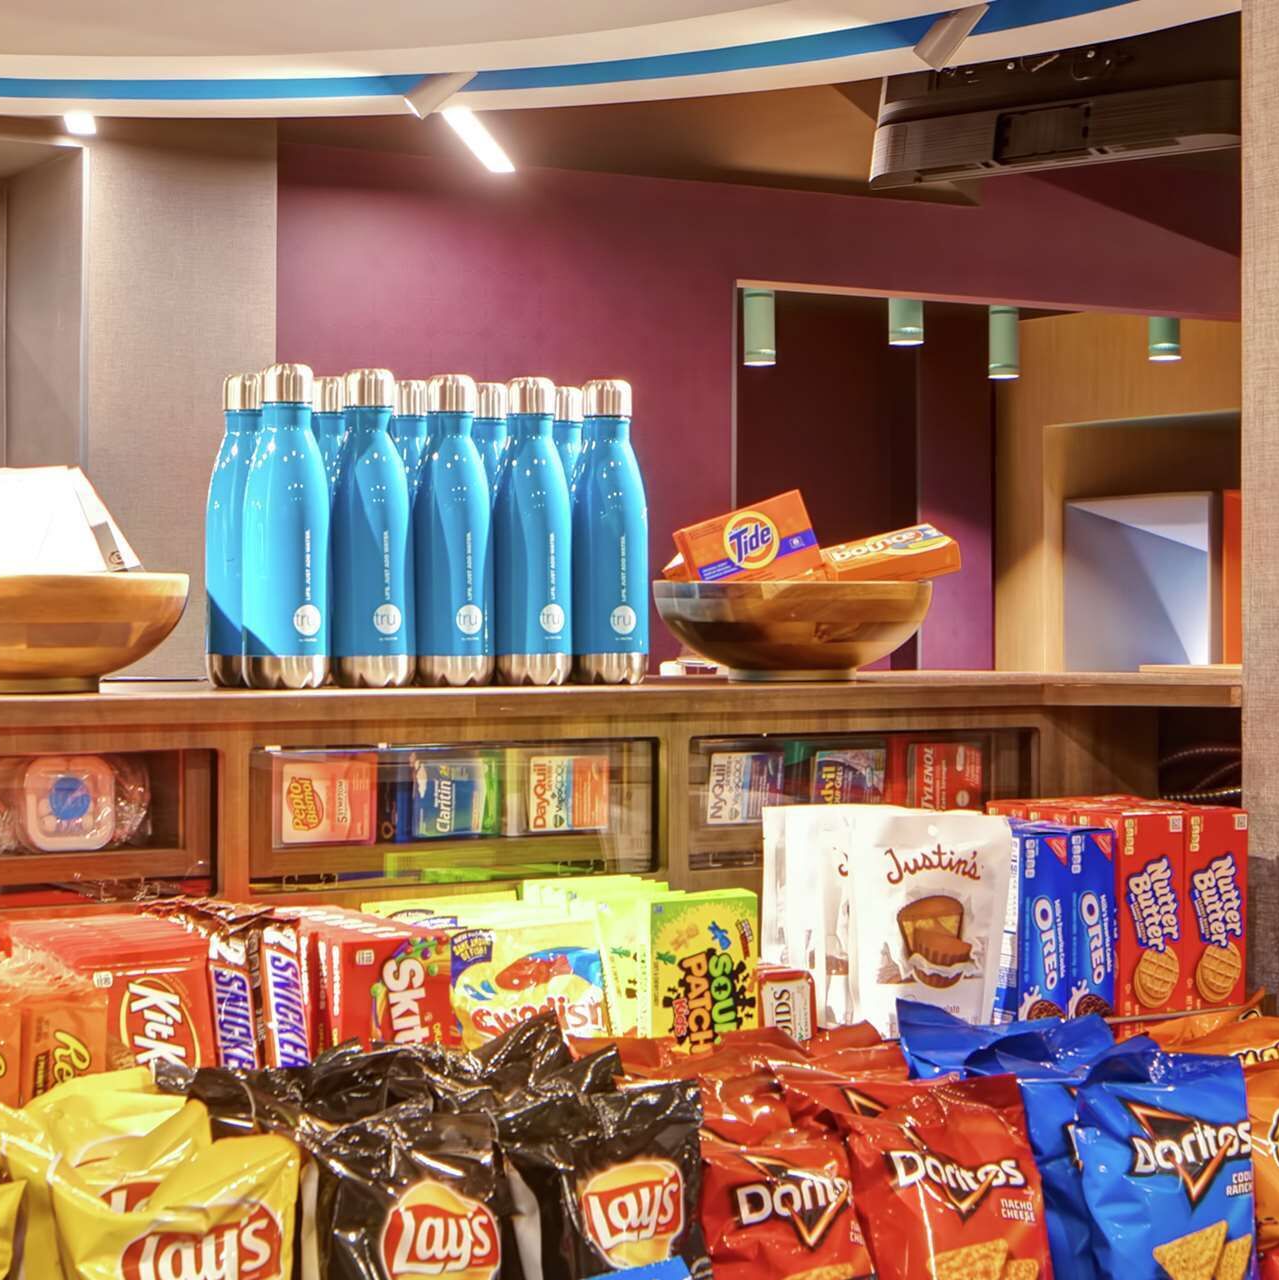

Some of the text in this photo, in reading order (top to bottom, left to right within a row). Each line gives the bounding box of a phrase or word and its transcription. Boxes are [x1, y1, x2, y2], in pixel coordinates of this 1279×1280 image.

[728, 525, 773, 564] Tide
[375, 610, 396, 626] tru
[458, 610, 478, 626] tru
[541, 611, 560, 626] tru
[612, 612, 631, 626] tru
[300, 778, 320, 824] Bismol
[532, 763, 550, 829] DayQuil
[710, 763, 727, 819] NyQuil
[821, 765, 837, 805] dvil
[920, 746, 934, 809] TYLENOL
[289, 782, 308, 831] Pepto
[435, 780, 453, 833] Claritin
[884, 844, 981, 884] Justin's
[1129, 873, 1166, 952] Butter
[1147, 857, 1179, 940] Nutter
[1193, 870, 1228, 948] Butter
[1211, 855, 1242, 938] Nutter
[1033, 897, 1058, 990] OREO
[1080, 892, 1105, 985] OREO
[213, 968, 257, 1069] SNICKE
[270, 952, 312, 1068] SNICKER
[672, 998, 691, 1038] Kids
[680, 951, 713, 1054] PATCH
[889, 1150, 1026, 1193] Doritos
[1133, 1121, 1252, 1174] Doritos
[587, 1176, 679, 1251] Lay's
[736, 1177, 854, 1226] Dorito
[1000, 1198, 1033, 1212] NACHO
[1001, 1209, 1036, 1223] CHEESE
[392, 1204, 491, 1275] Lay's
